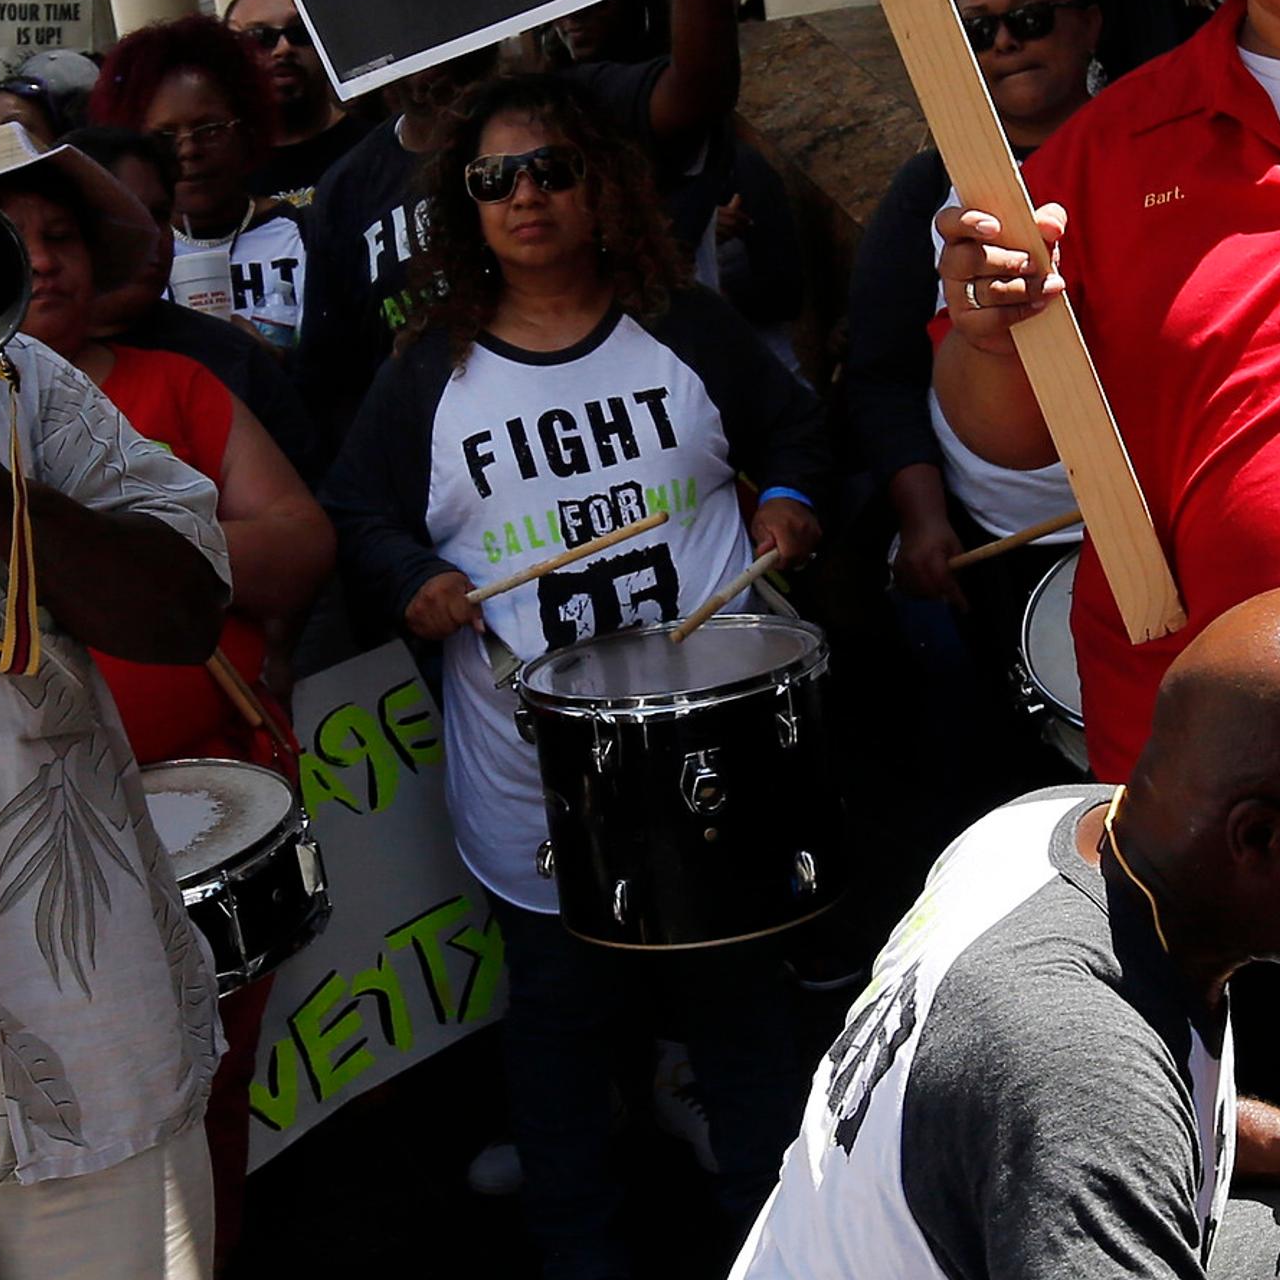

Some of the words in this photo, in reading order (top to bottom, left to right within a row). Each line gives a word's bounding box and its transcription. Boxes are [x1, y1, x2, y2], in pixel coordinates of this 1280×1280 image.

[43, 3, 81, 21] TIME
[17, 26, 30, 45] IS
[35, 26, 62, 45] UP!
[462, 386, 678, 499] FIGHT
